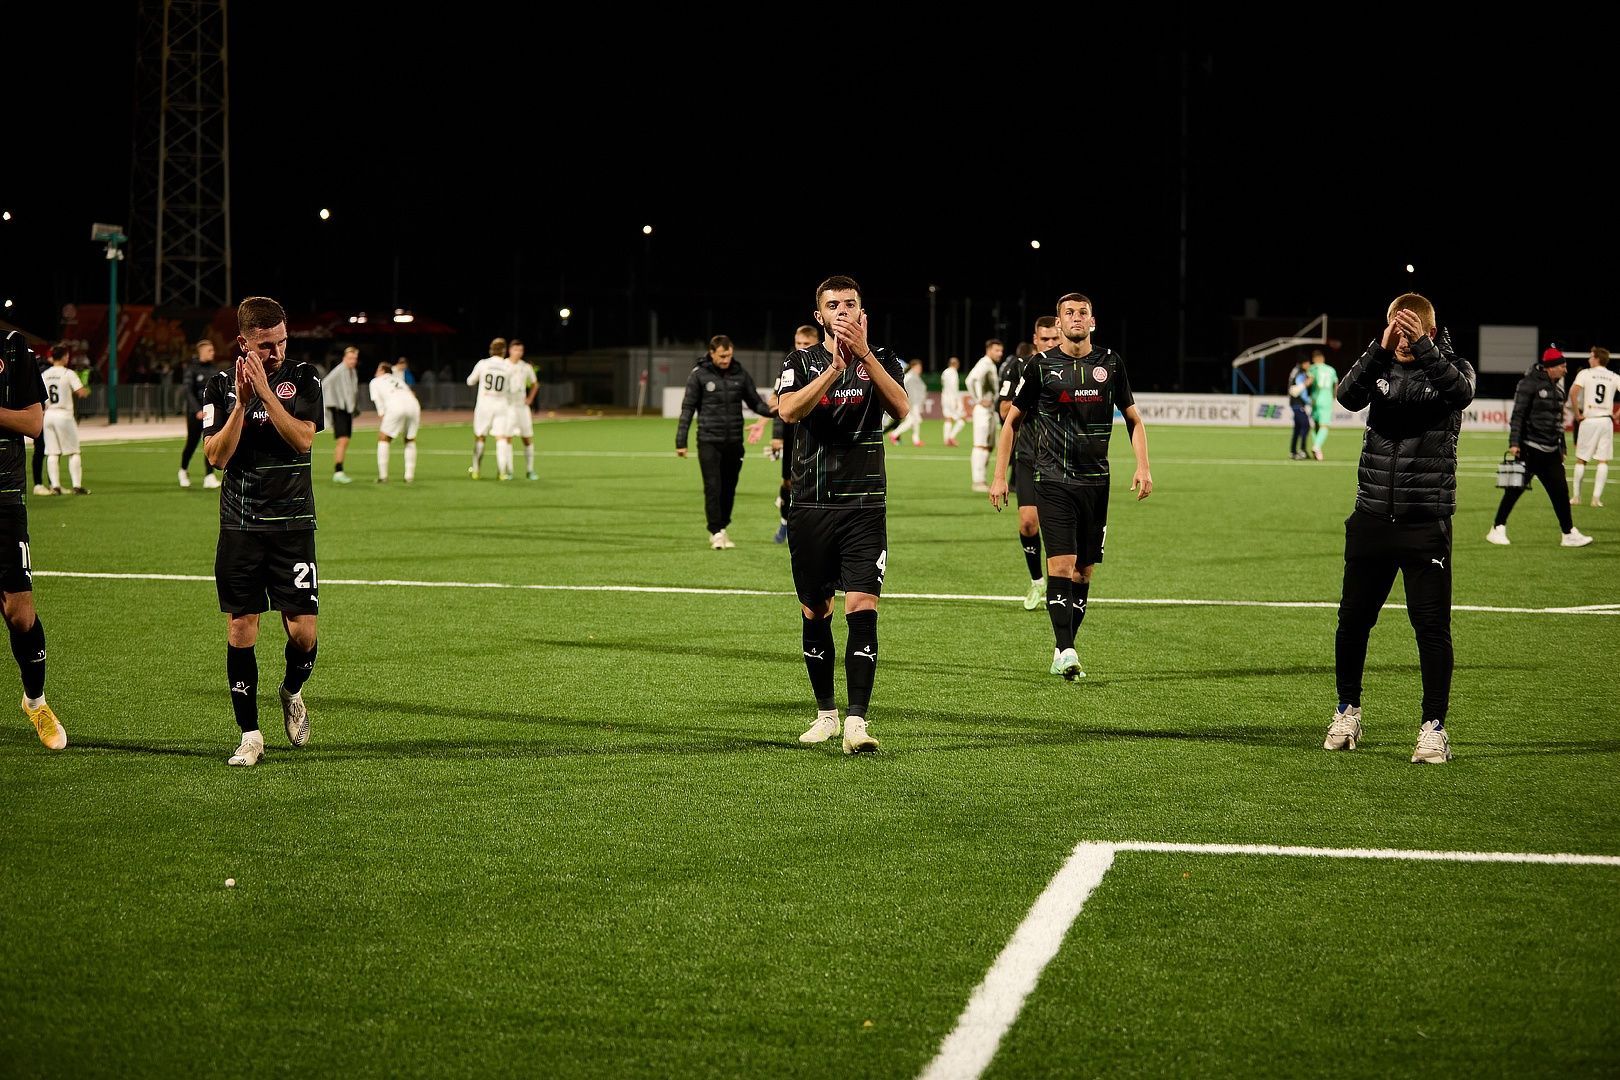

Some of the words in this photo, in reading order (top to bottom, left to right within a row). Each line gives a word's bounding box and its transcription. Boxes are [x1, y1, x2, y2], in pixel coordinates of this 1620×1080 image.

[484, 373, 505, 392] 90
[49, 384, 60, 404] 6
[834, 388, 863, 398] AKRON
[1074, 389, 1099, 397] AKRON
[1594, 383, 1606, 404] 9
[876, 549, 887, 576] 4
[293, 562, 318, 589] 21
[863, 645, 871, 653] 4
